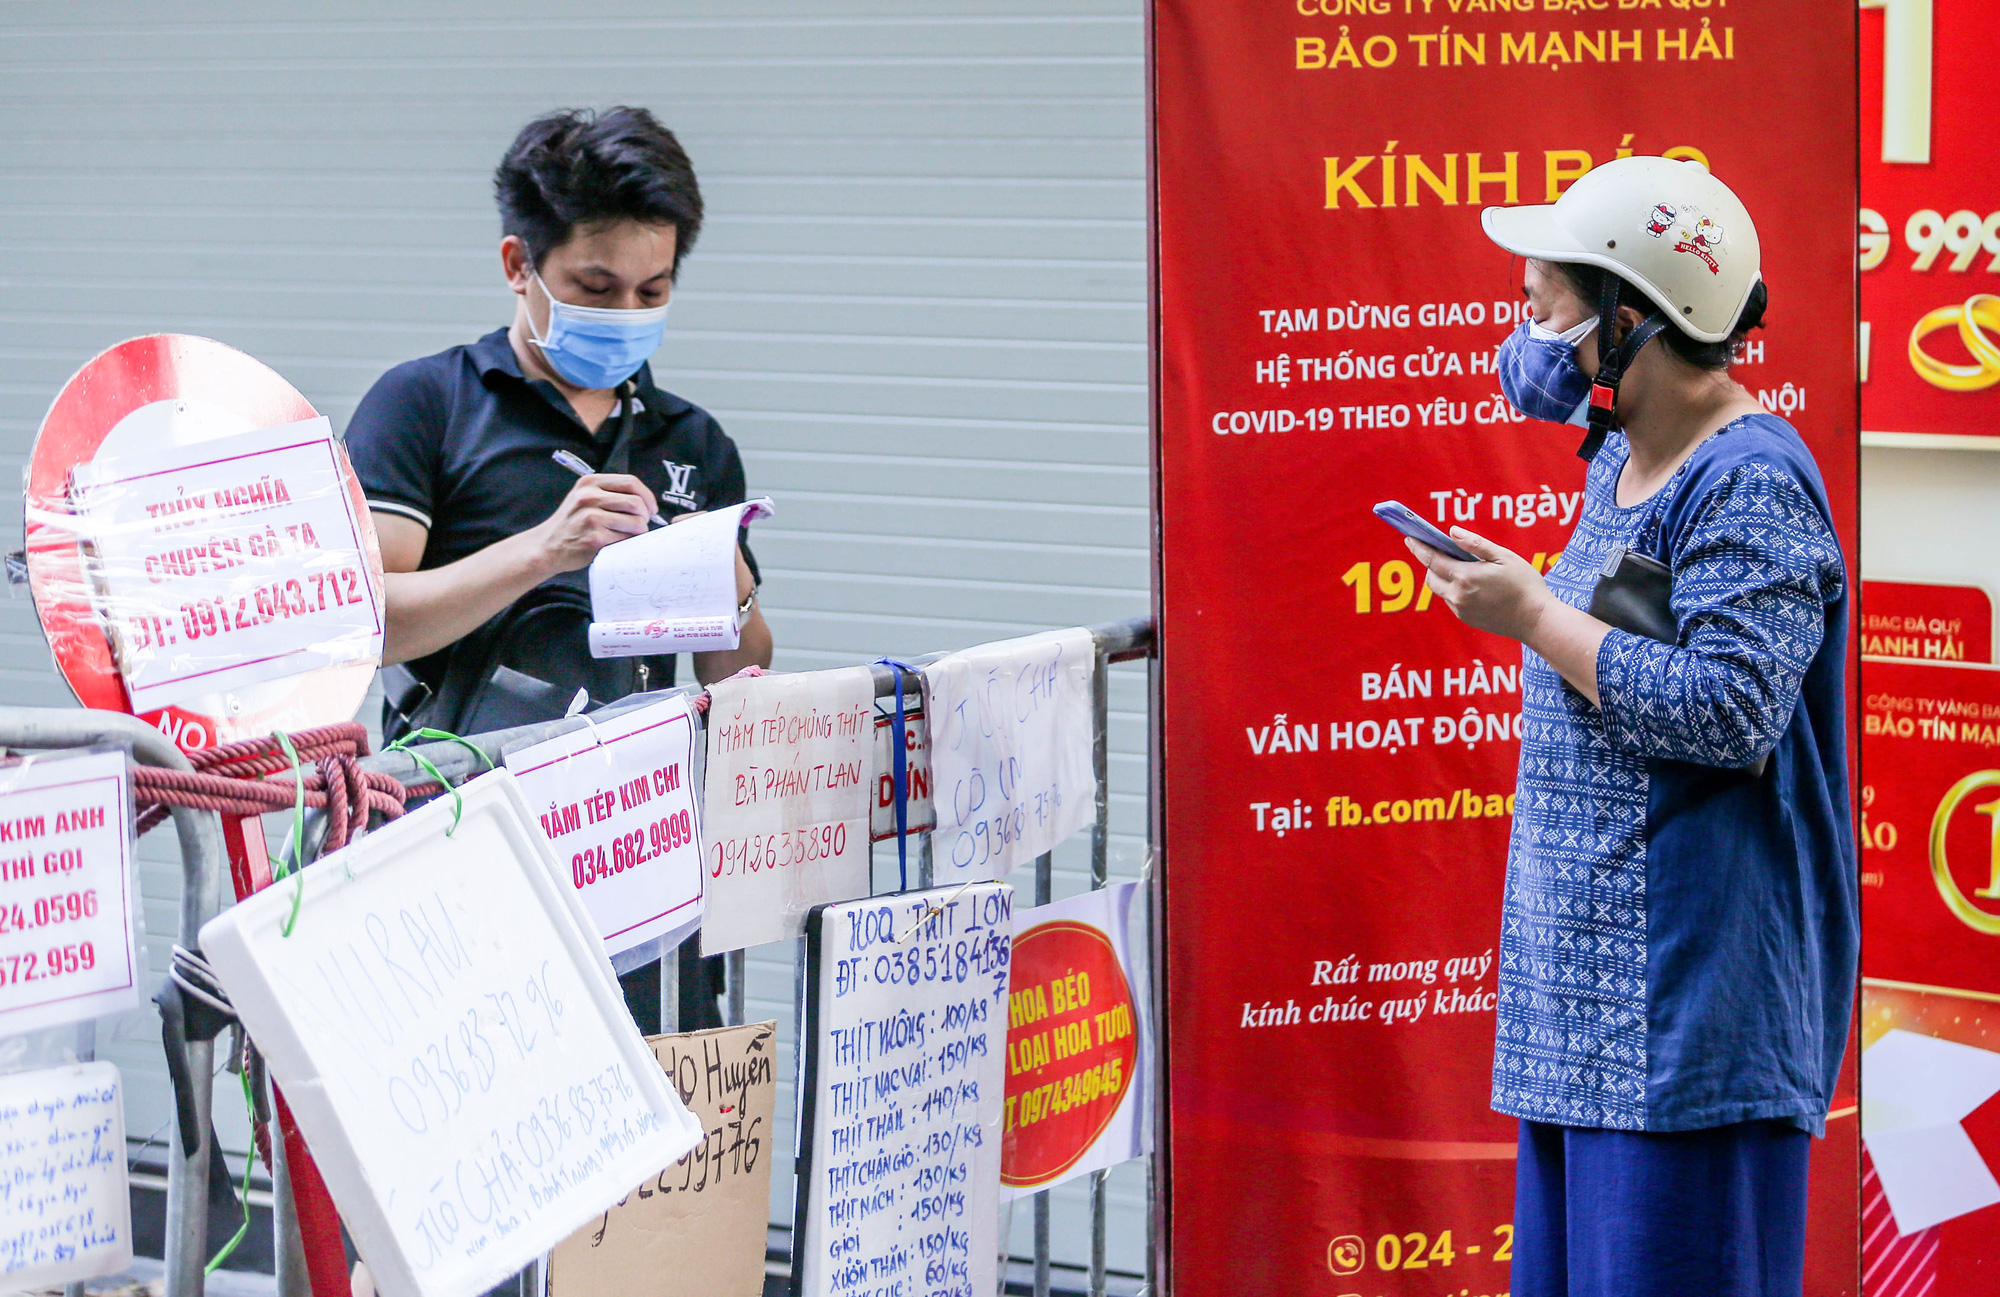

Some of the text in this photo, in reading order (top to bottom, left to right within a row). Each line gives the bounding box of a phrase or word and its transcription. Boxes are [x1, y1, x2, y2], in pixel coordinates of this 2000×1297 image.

[1295, 17, 1735, 70] BẢO TÍN MẠNH HẢI
[1323, 140, 1519, 209] KÍNH
[1681, 244, 1717, 267] HELLO KITTY
[1259, 308, 1318, 338] TẠM
[1327, 300, 1411, 330] DỪNG
[1418, 302, 1486, 326] GIAO
[1256, 353, 1291, 388] HỆ
[1297, 348, 1396, 381] THỐNG
[1403, 345, 1463, 376] CỬA
[1212, 408, 1334, 435] COVID-19
[1339, 404, 1410, 430] THEO
[1416, 396, 1467, 426] YÊU
[1758, 382, 1805, 418] NỘI
[1429, 488, 1483, 522] Từ
[181, 567, 363, 640] 0912.643.712
[1361, 659, 1523, 701] BÁN HÀN
[761, 701, 786, 746] TÉP
[837, 704, 869, 743] THỊT
[1865, 710, 1915, 738] BẢO
[1918, 715, 1957, 742] TÍN
[1916, 697, 1935, 715] TY
[157, 710, 208, 750] NO
[1246, 713, 1319, 755] VẪN
[1330, 717, 1425, 755] HOẠT
[584, 788, 616, 825] TÉP
[619, 775, 651, 812] KIM
[653, 763, 681, 796] CHI
[1, 805, 105, 843] KIM ANH
[1250, 799, 1313, 837] Tại:
[44, 847, 83, 877] GỌI
[572, 809, 692, 890] 034.682.9999
[711, 822, 846, 879] 0912635890
[1310, 948, 1493, 986] Rất mong quý
[1051, 968, 1090, 1015] BÉO
[1240, 986, 1499, 1028] kính chúc quý khác
[1008, 1031, 1050, 1075] LOẠI
[1053, 1018, 1092, 1060] HOA
[1020, 1058, 1122, 1127] 0974349645
[1376, 1230, 1456, 1271] 024
